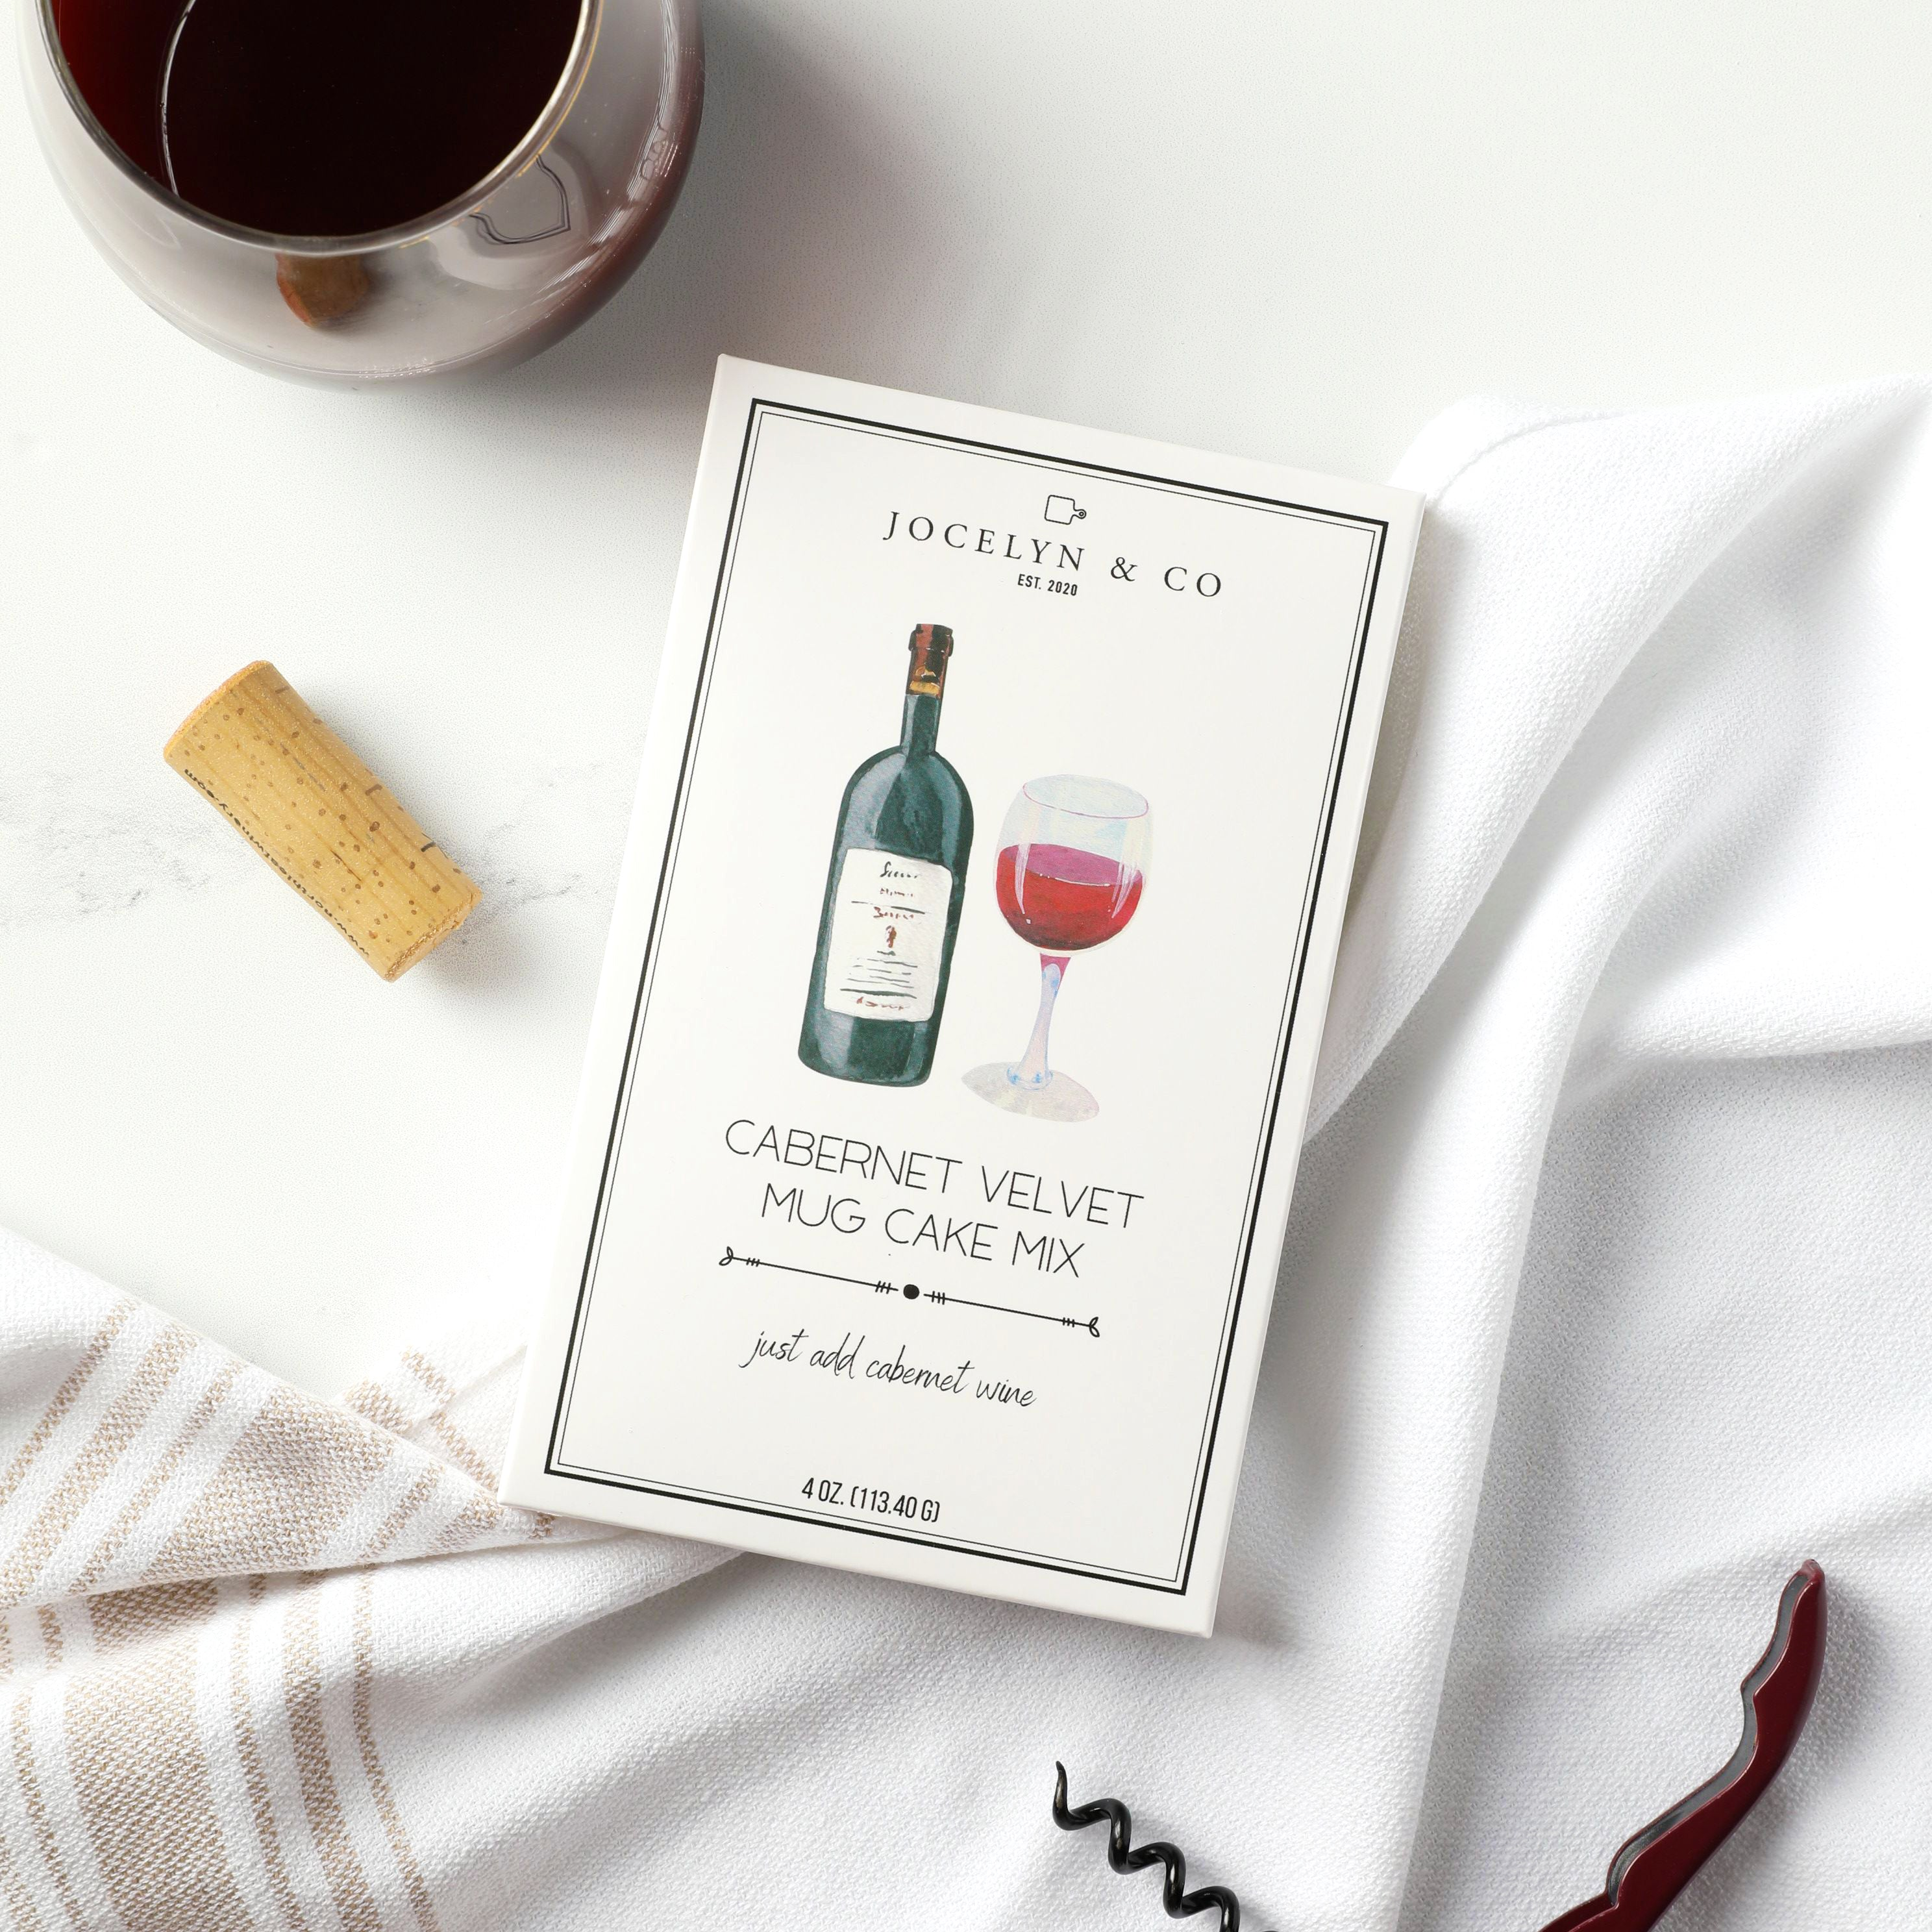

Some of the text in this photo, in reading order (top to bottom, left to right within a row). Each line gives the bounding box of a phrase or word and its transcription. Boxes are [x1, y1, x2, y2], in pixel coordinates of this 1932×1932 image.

[882, 511, 1221, 597] JOCELYN & CO
[1017, 573, 1078, 597] EST. 2020
[725, 1119, 1145, 1228] CABERNET VELVET
[762, 1183, 1085, 1278] MUG CAKE MIX
[738, 1328, 1037, 1407] just add cabernet wine
[801, 1477, 941, 1523] 4 OZ. (113.40 G)
